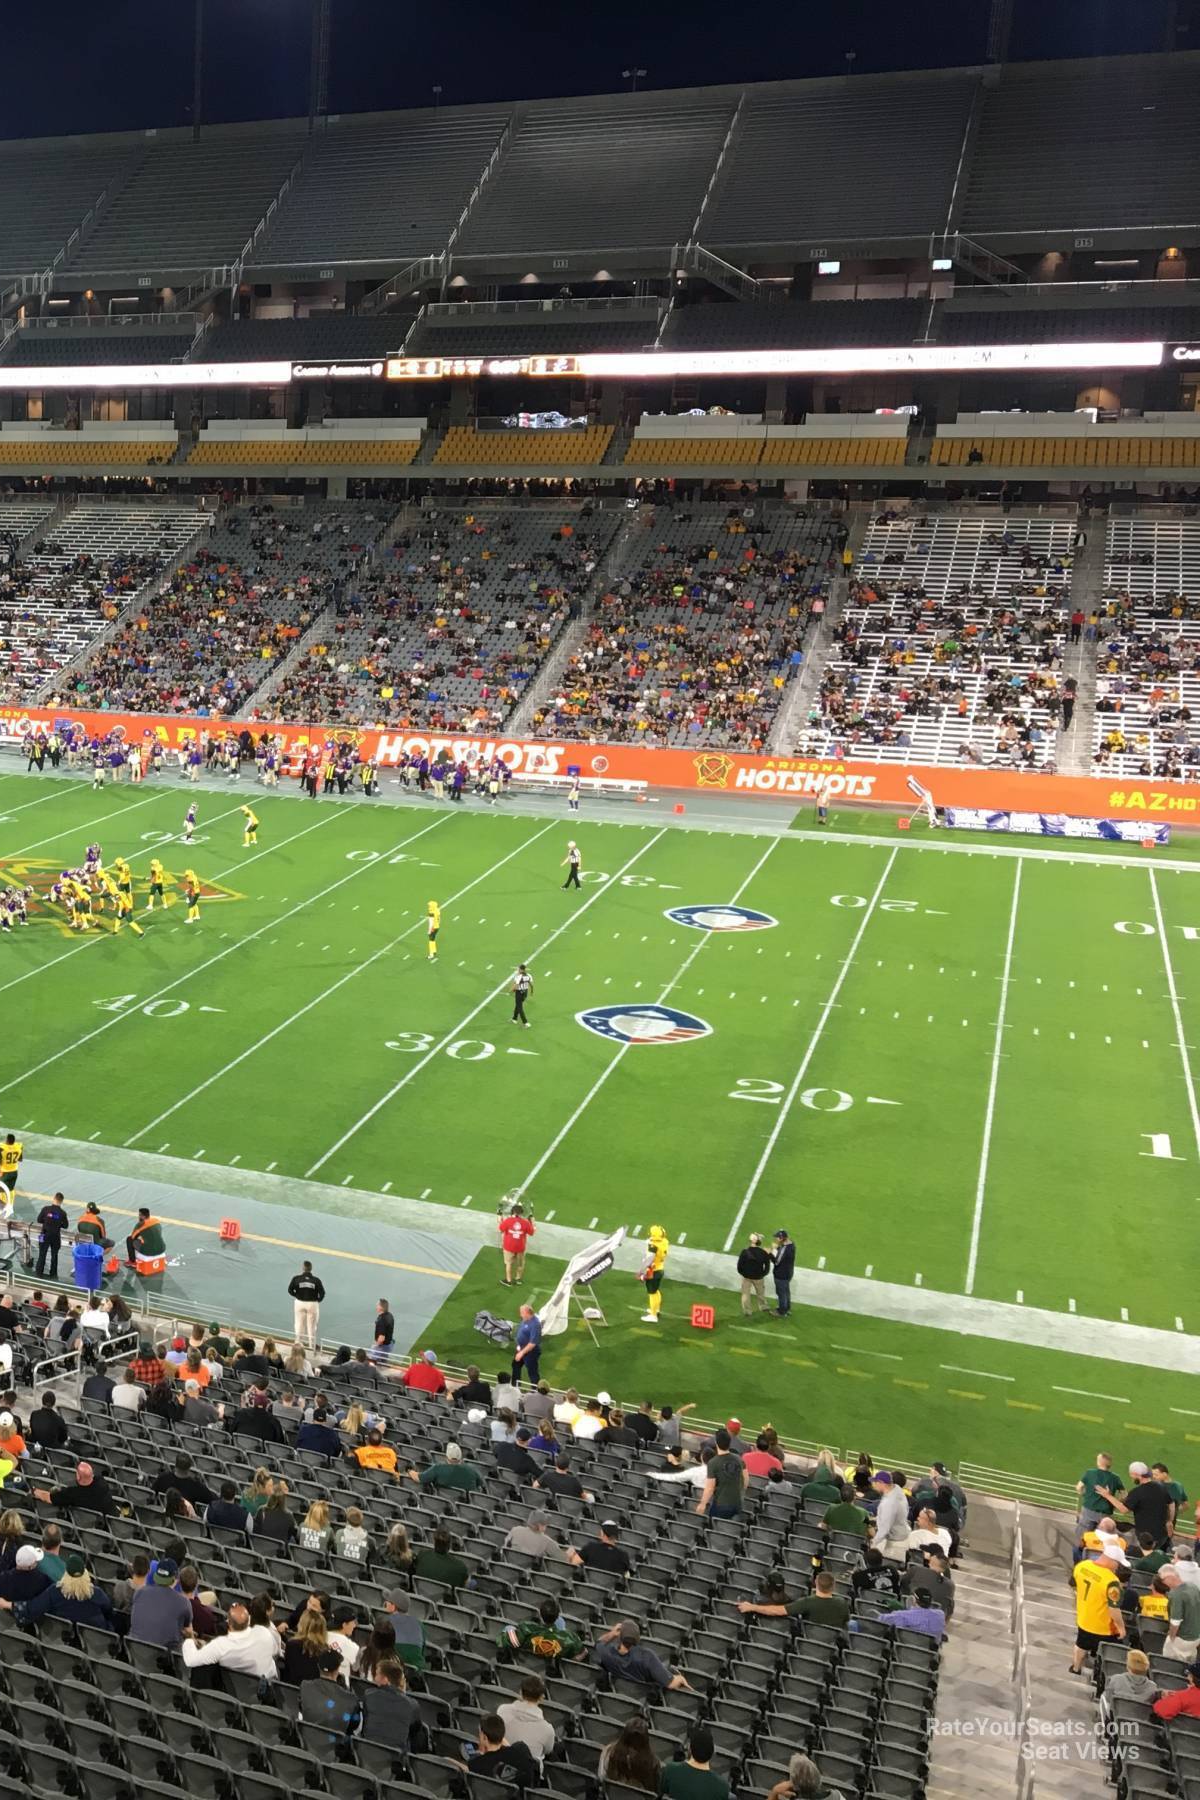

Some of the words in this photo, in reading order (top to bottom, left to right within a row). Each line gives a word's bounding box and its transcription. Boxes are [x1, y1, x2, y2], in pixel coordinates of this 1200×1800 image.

[376, 735, 566, 774] HOTSHOTS
[765, 761, 845, 773] ARIZONA
[735, 768, 877, 796] HOTSHOTS
[1109, 791, 1200, 811] #AZHO
[91, 994, 191, 1018] 40
[384, 1032, 496, 1060] 30
[728, 1078, 854, 1112] 20
[5, 1152, 18, 1164] 92
[223, 1221, 236, 1236] 30
[152, 1261, 160, 1270] G
[694, 1308, 712, 1326] 20
[343, 1549, 360, 1559] CLUB
[1083, 1580, 1091, 1601] 7
